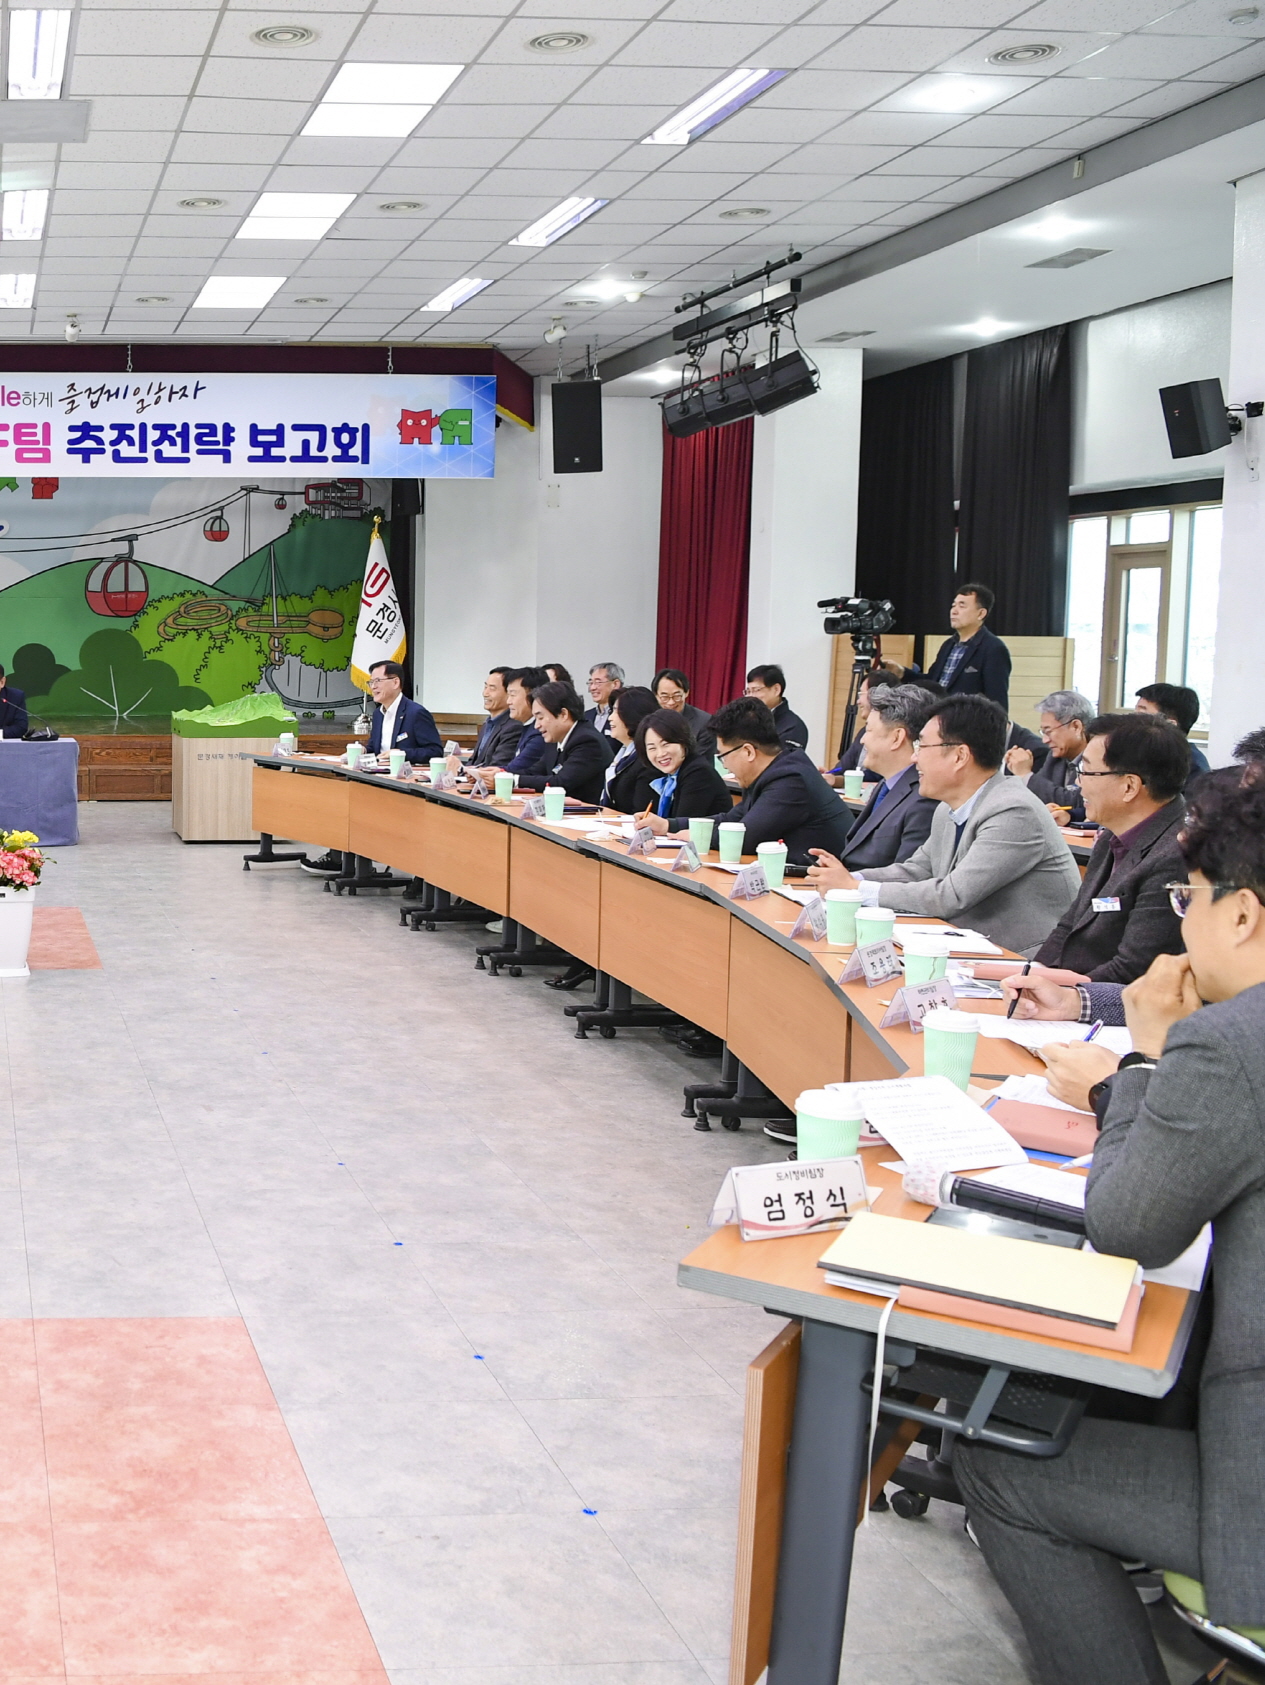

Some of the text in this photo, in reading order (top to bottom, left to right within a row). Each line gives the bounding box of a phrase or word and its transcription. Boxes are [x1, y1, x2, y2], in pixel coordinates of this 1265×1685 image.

[58, 382, 129, 415] 즐겁게
[133, 380, 207, 414] 일하자
[66, 421, 236, 464] 추진전략
[247, 422, 370, 465] 보고회
[763, 1185, 848, 1222] 엄정식
